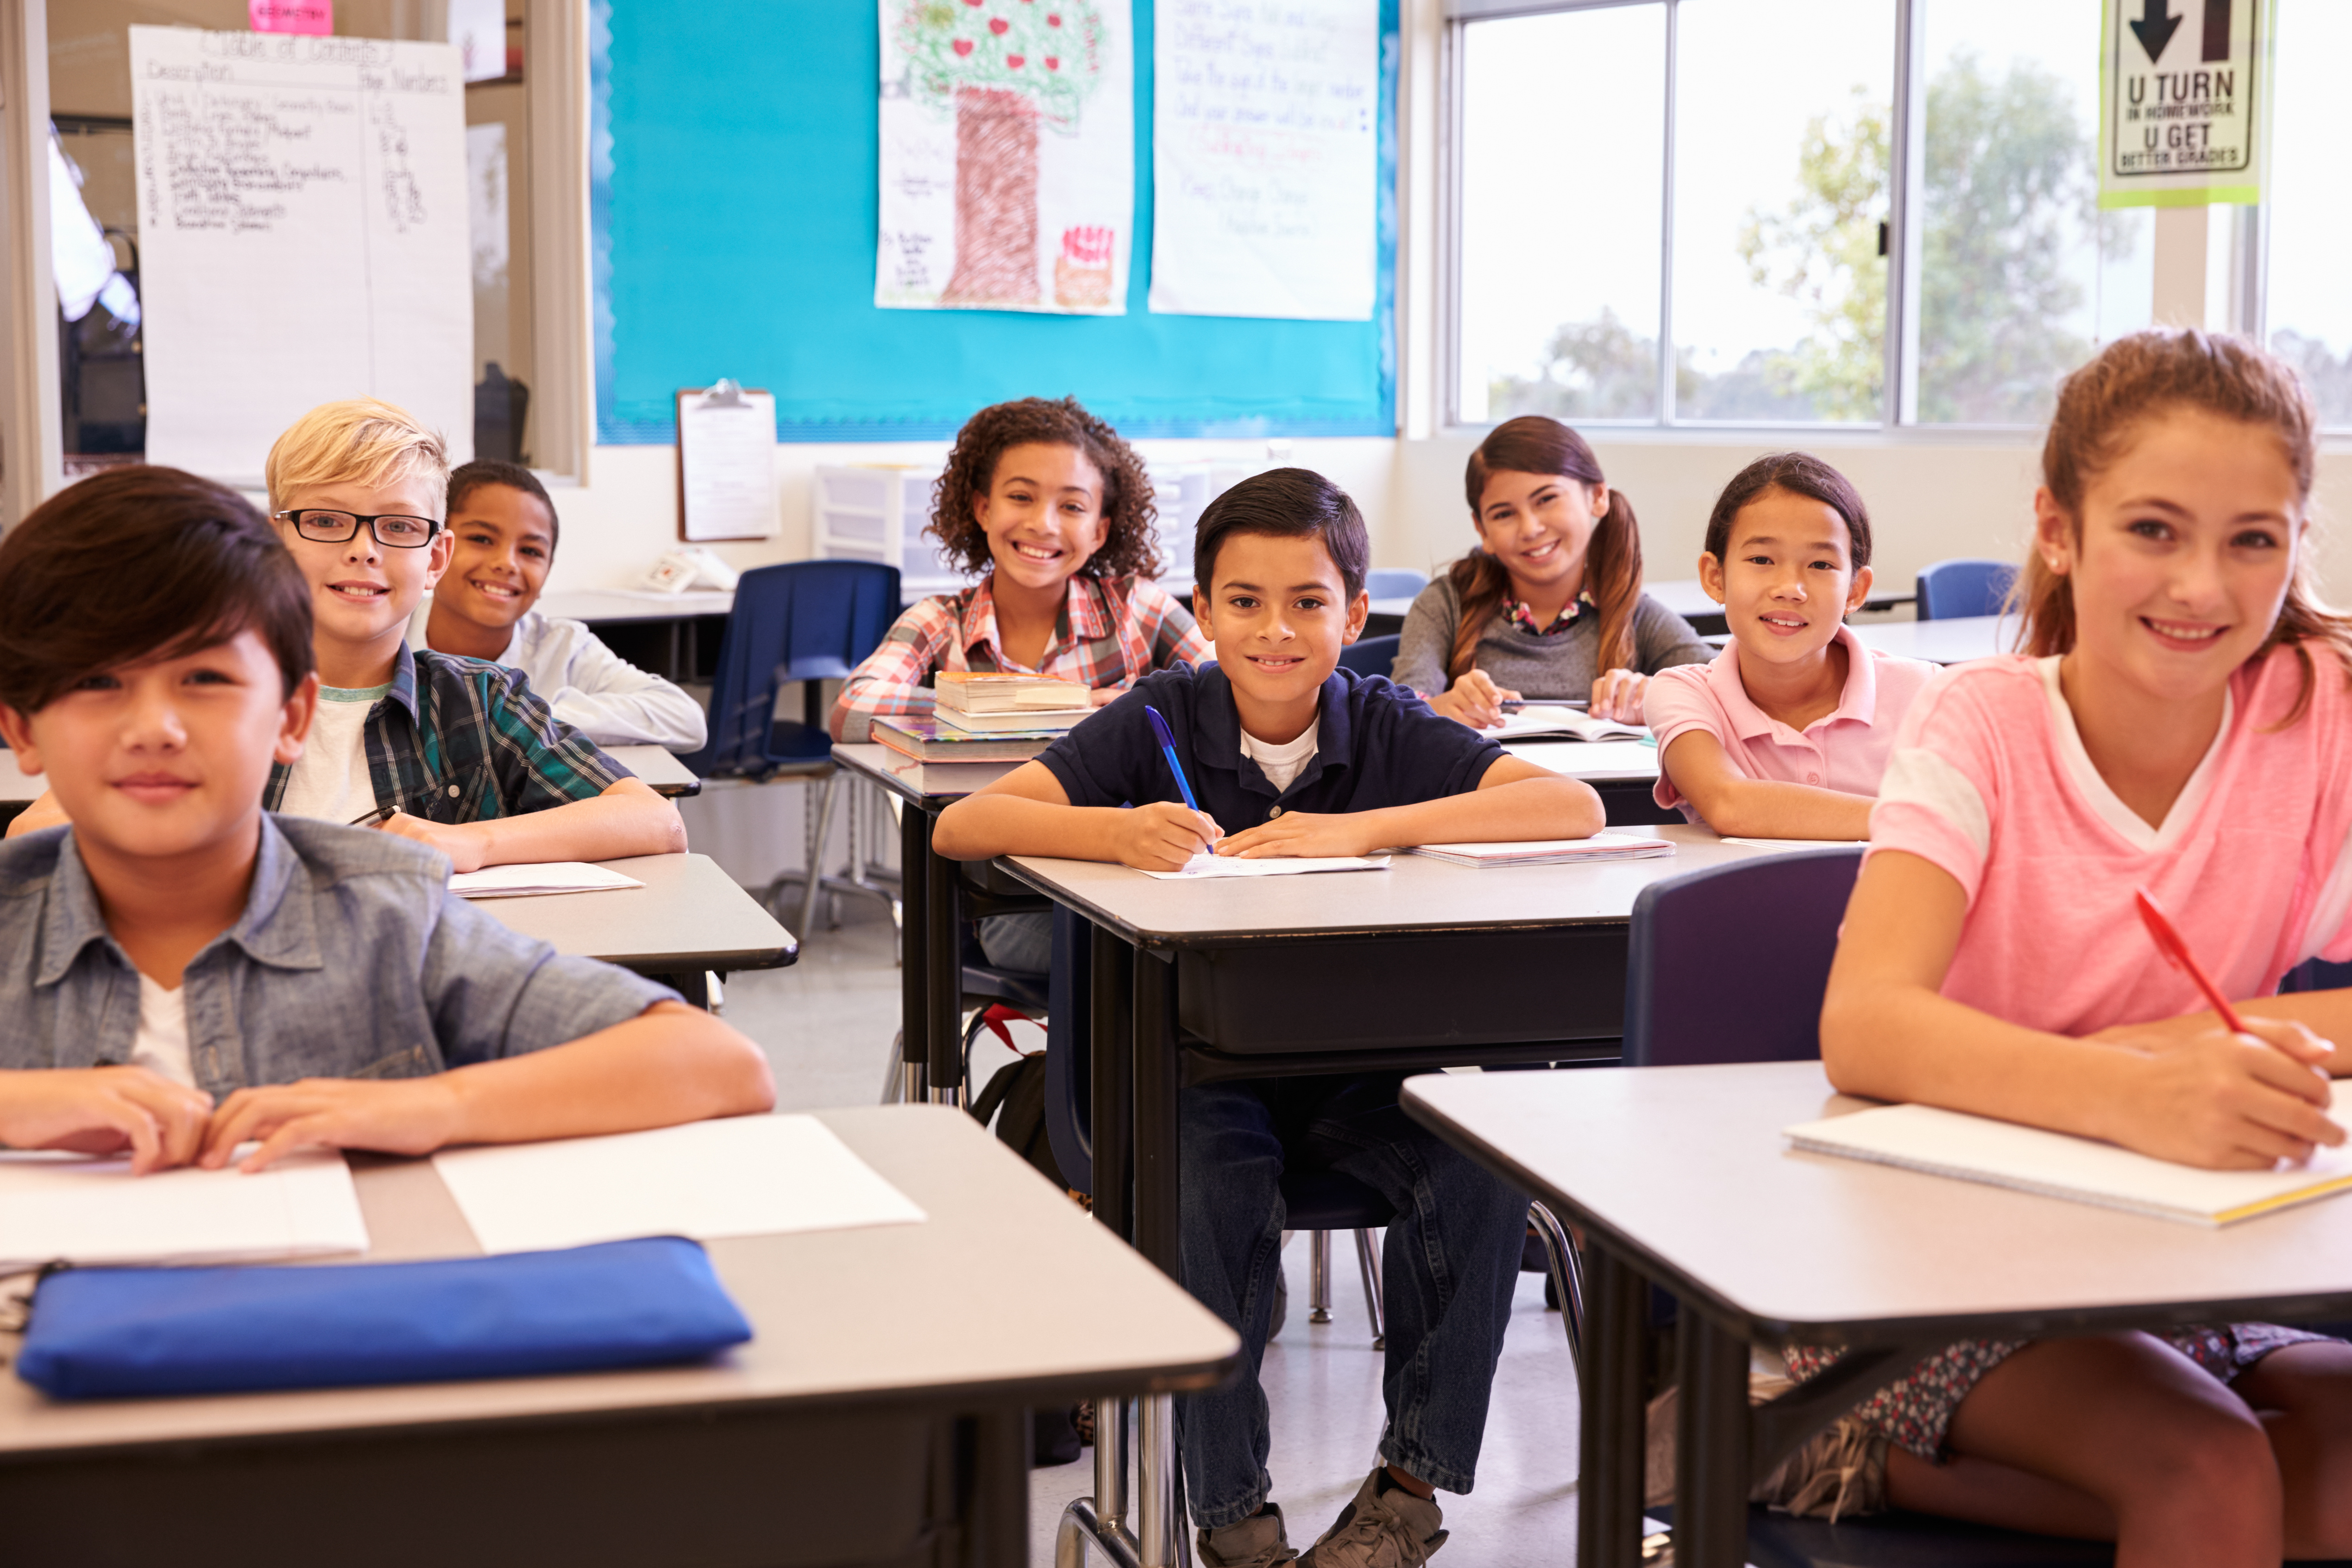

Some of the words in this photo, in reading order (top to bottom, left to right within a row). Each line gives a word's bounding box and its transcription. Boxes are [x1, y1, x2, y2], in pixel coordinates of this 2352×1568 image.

[2128, 75, 2146, 105] U
[2156, 69, 2234, 105] TURN
[2127, 106, 2141, 121] IN
[2145, 101, 2234, 120] HOMEWORK
[2145, 125, 2158, 150] U
[2167, 122, 2212, 149] GET
[2121, 152, 2171, 168] BETTER
[2178, 147, 2238, 165] GRADES
